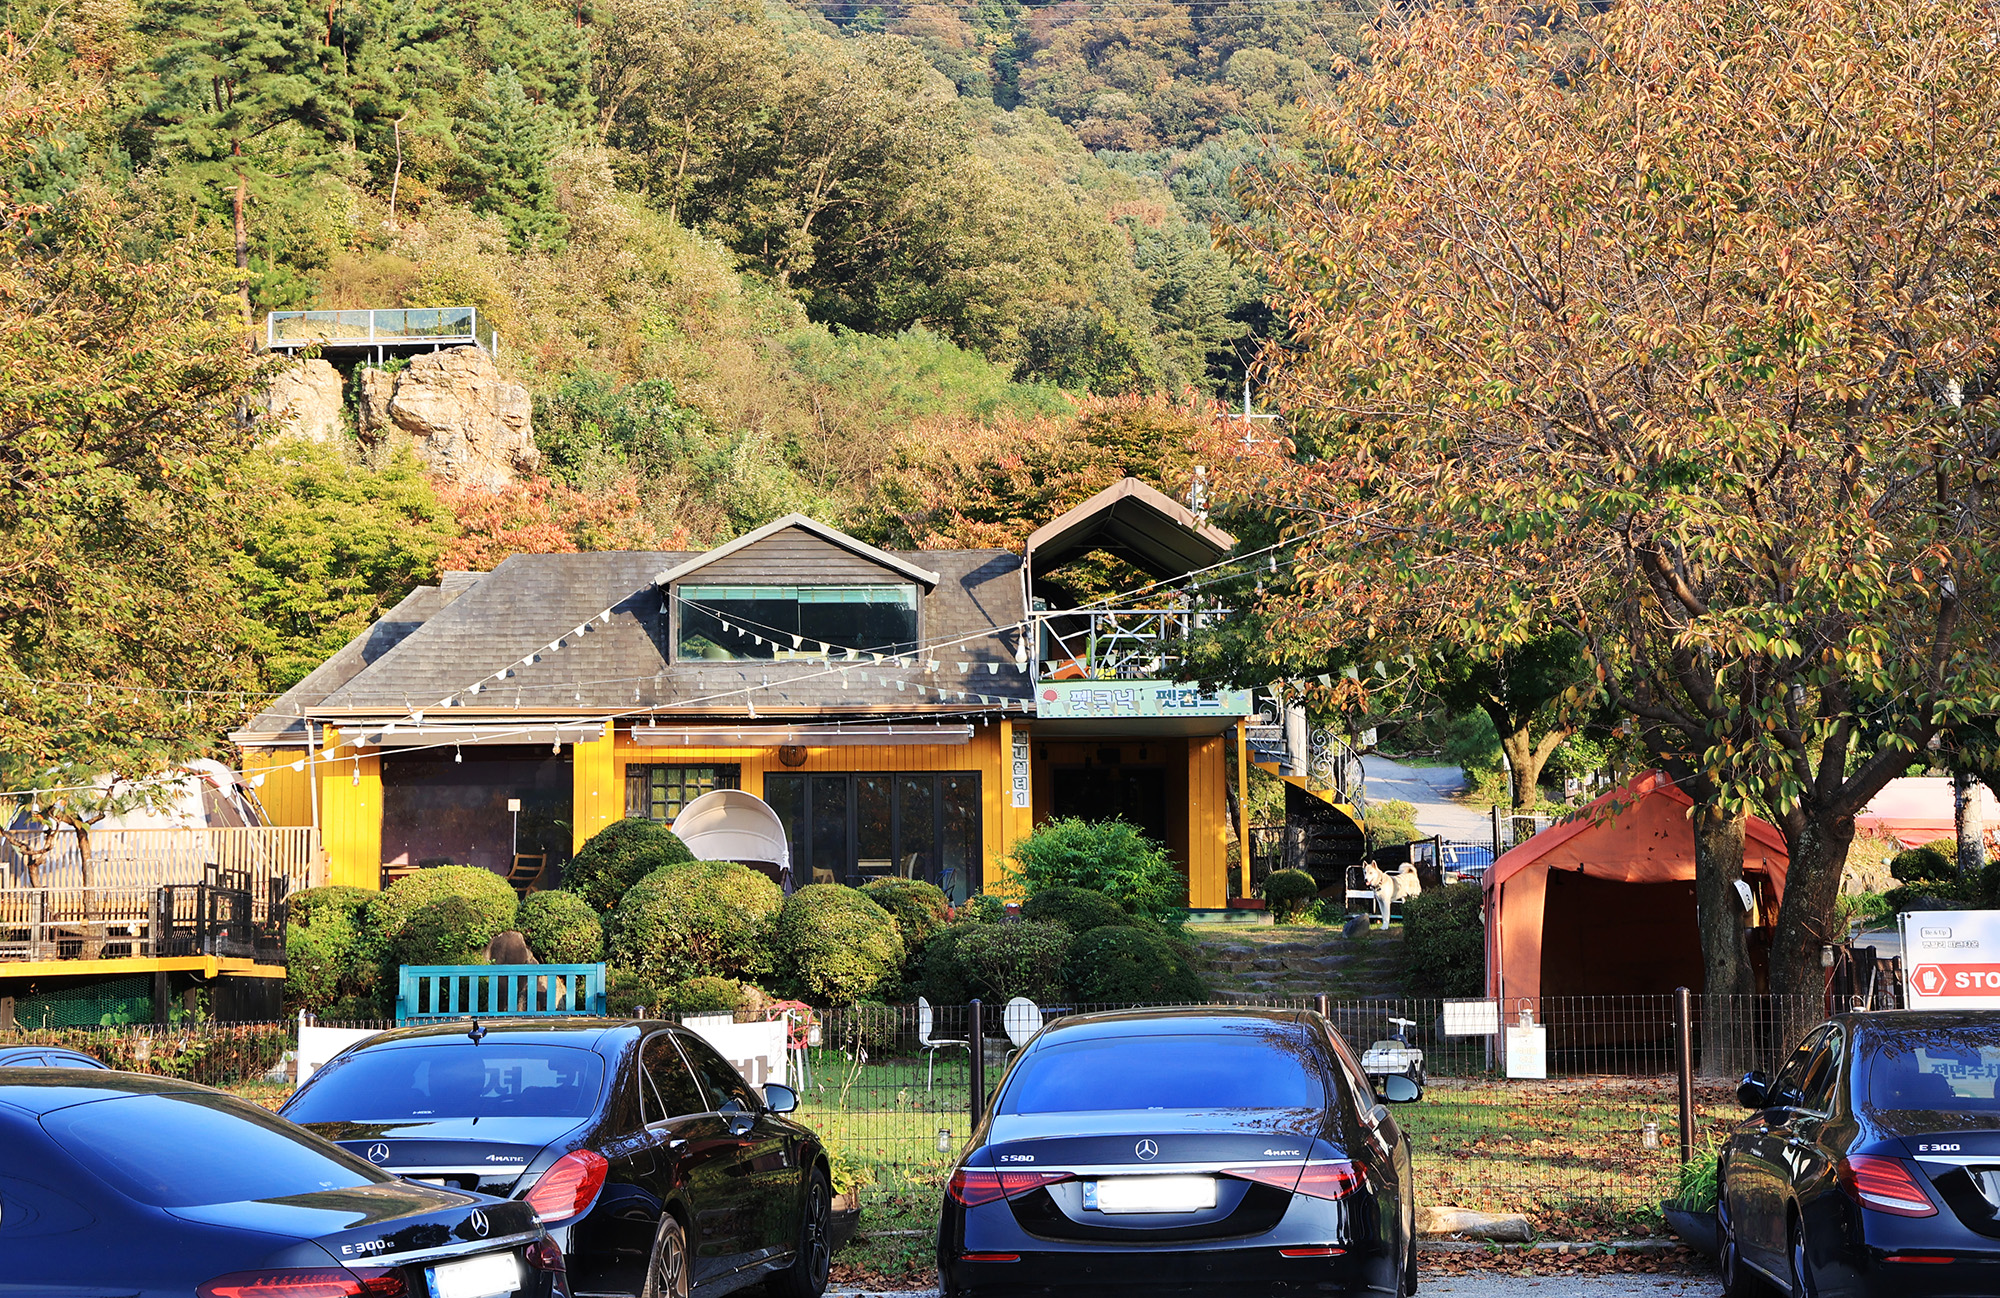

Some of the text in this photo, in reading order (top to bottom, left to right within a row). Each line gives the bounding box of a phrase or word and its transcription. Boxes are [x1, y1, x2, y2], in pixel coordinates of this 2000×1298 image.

[1070, 688, 1135, 710] 펫크닉
[1263, 1148, 1300, 1156] 4MATIC
[1931, 1143, 1960, 1152] 300
[485, 1154, 524, 1162] 4MATIC
[341, 1245, 354, 1255] E
